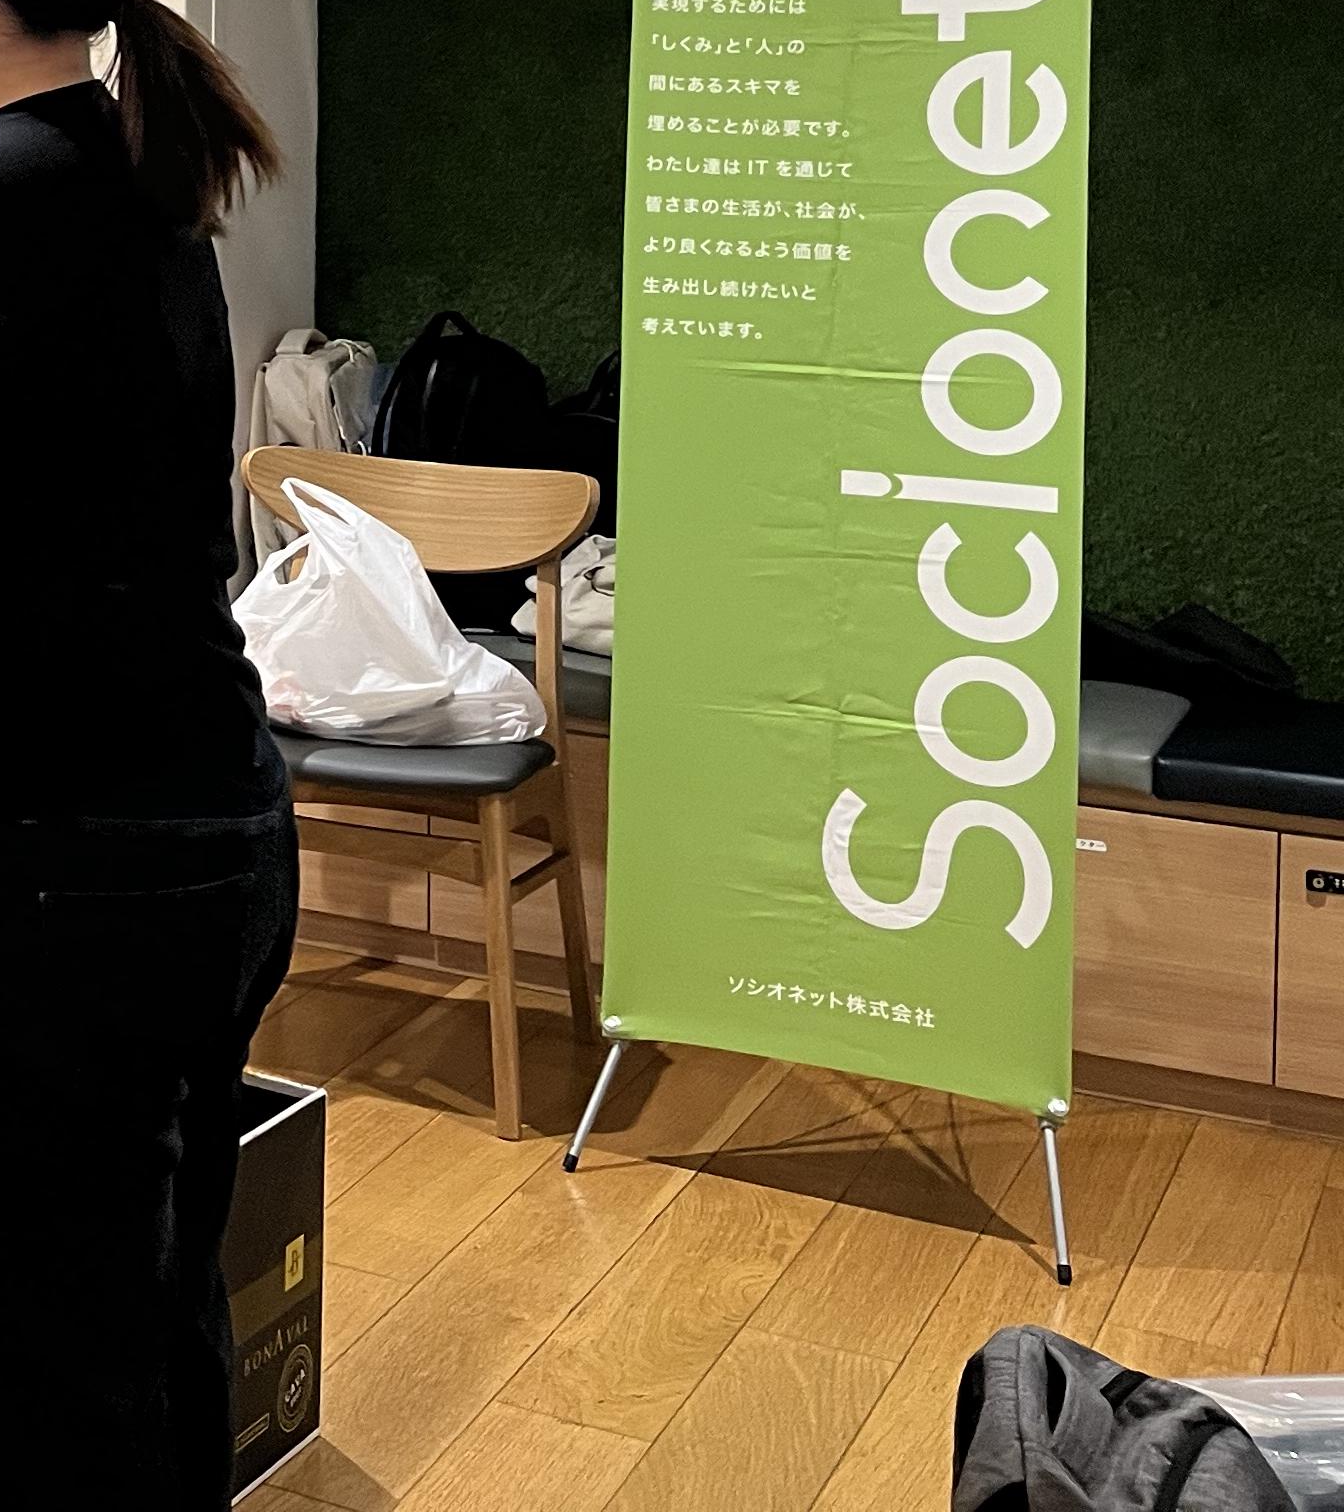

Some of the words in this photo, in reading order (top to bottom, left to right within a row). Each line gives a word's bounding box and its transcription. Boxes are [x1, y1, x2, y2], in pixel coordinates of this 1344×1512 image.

[651, 33, 806, 56] 「しくみ」と「人」の
[648, 74, 801, 96] 間にあるスキマを
[647, 115, 851, 138] 埋めることが必要です。
[646, 154, 741, 176] わたし達は
[748, 159, 769, 176] IT
[775, 160, 853, 178] を通じて
[644, 194, 866, 221] 皆さまの生活が、社会が、
[643, 235, 852, 262] より良くなるよう価値を
[642, 276, 817, 301] 生み出し続けたいと
[642, 317, 763, 340] 考えています。
[729, 976, 935, 1029] ソシオネット株式会社
